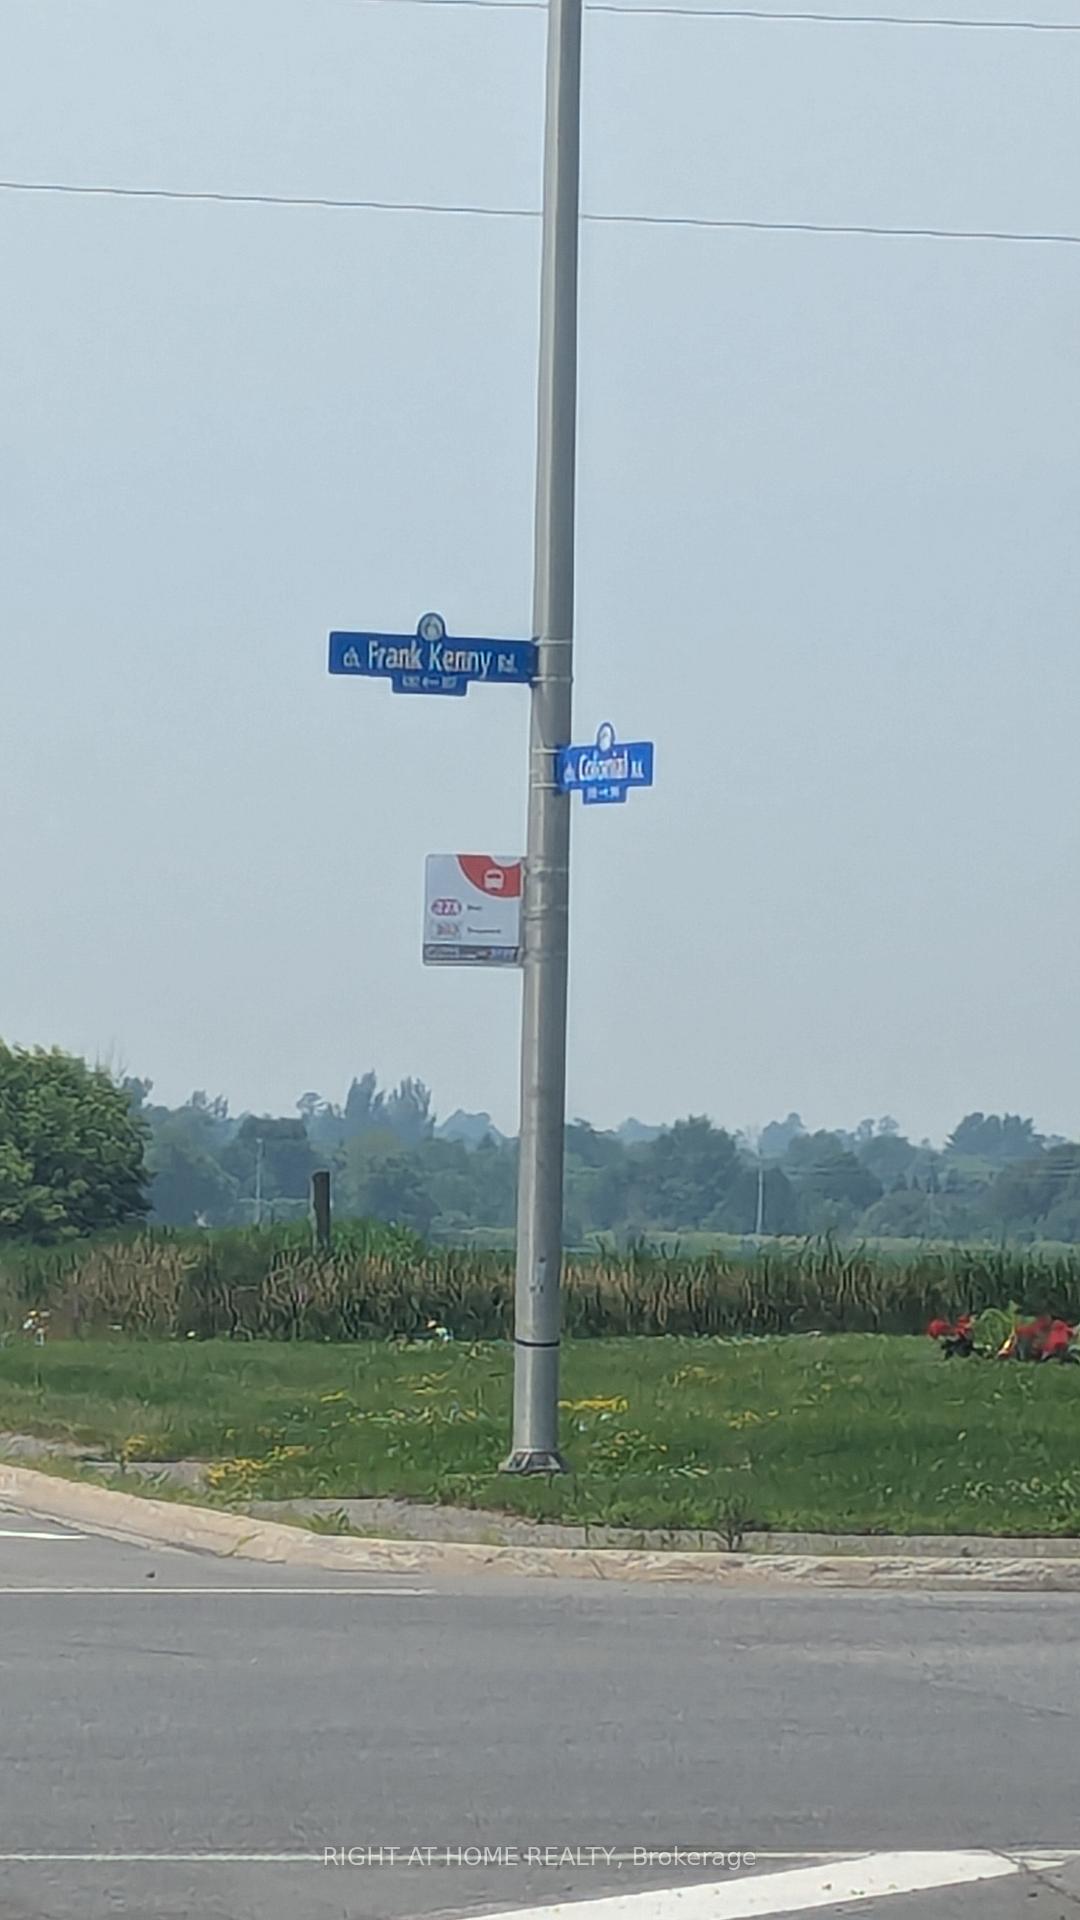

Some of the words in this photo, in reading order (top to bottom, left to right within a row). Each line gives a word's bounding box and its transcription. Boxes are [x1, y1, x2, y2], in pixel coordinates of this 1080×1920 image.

[368, 640, 423, 670] Frank
[428, 644, 491, 677] Kenny
[579, 750, 628, 781] Colonial
